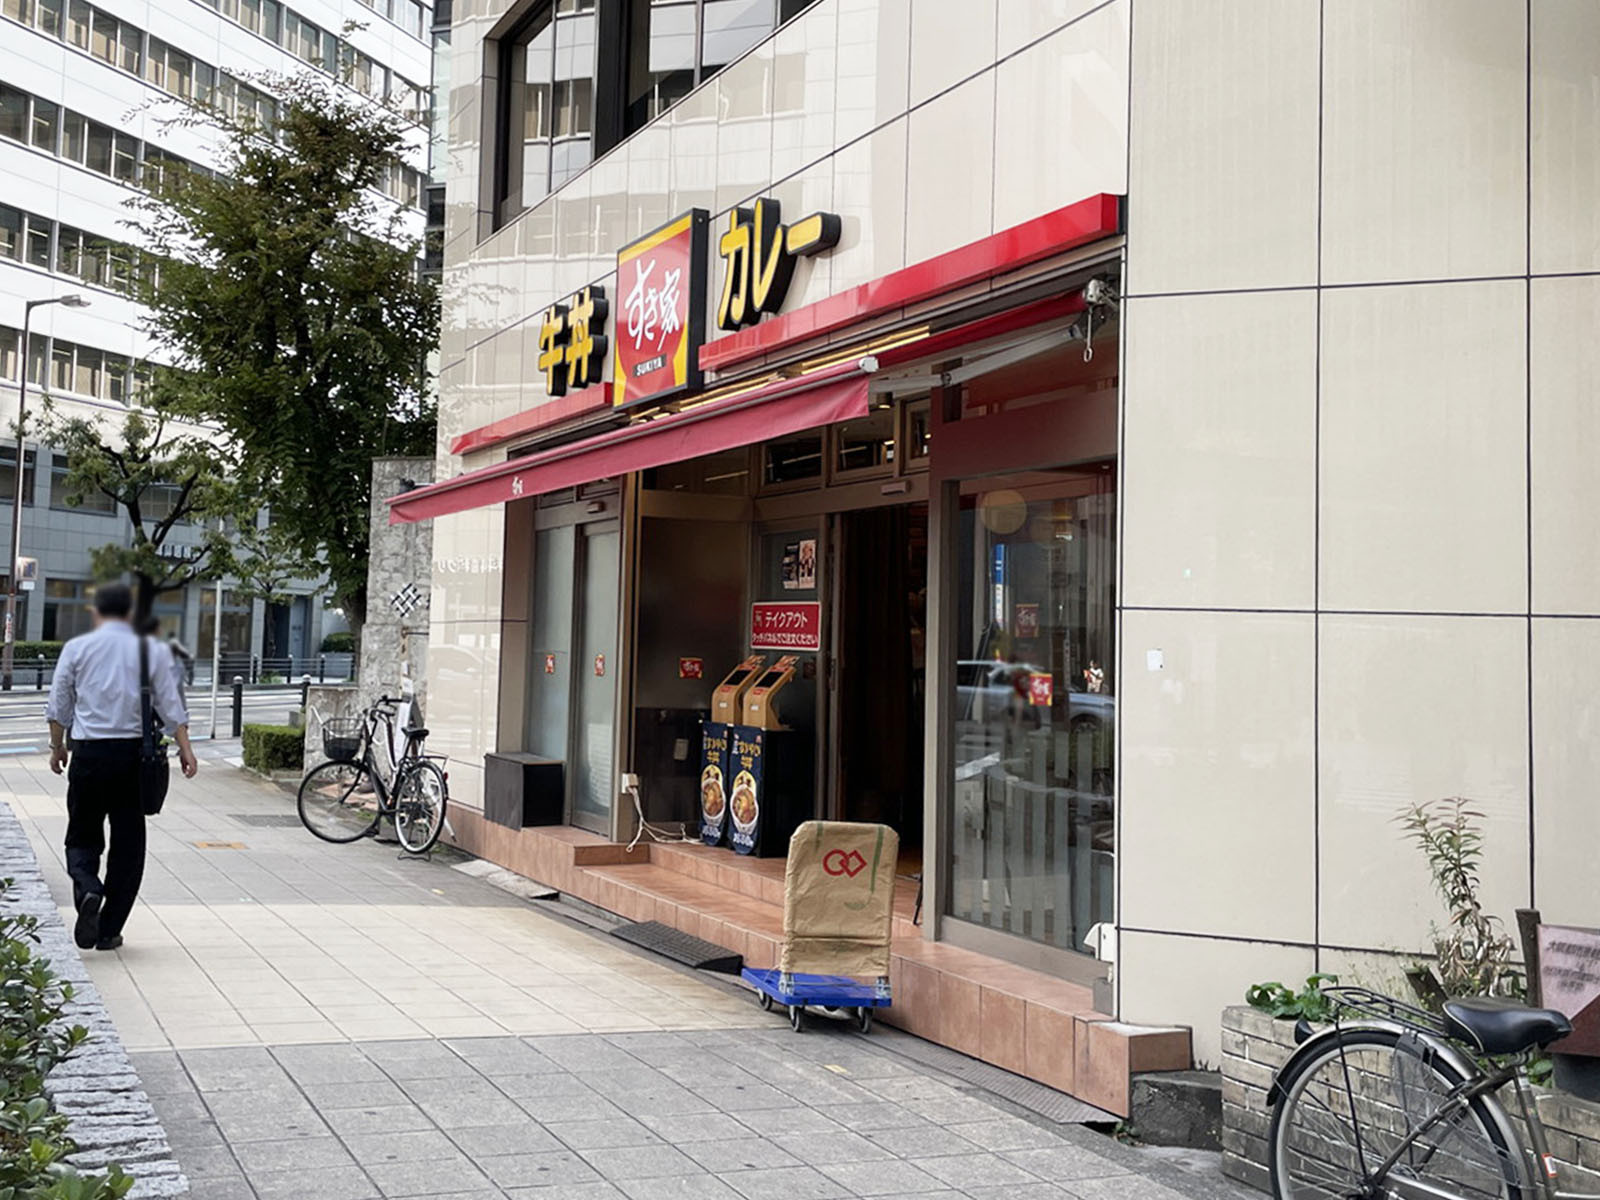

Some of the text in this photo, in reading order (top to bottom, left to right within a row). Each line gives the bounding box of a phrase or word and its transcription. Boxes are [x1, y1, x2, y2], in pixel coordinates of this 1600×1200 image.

[624, 258, 681, 352] すき家
[717, 197, 834, 330] カレー
[538, 286, 602, 396] 牛丼
[636, 356, 664, 377] SUKIYA
[765, 611, 808, 629] テイクアウト
